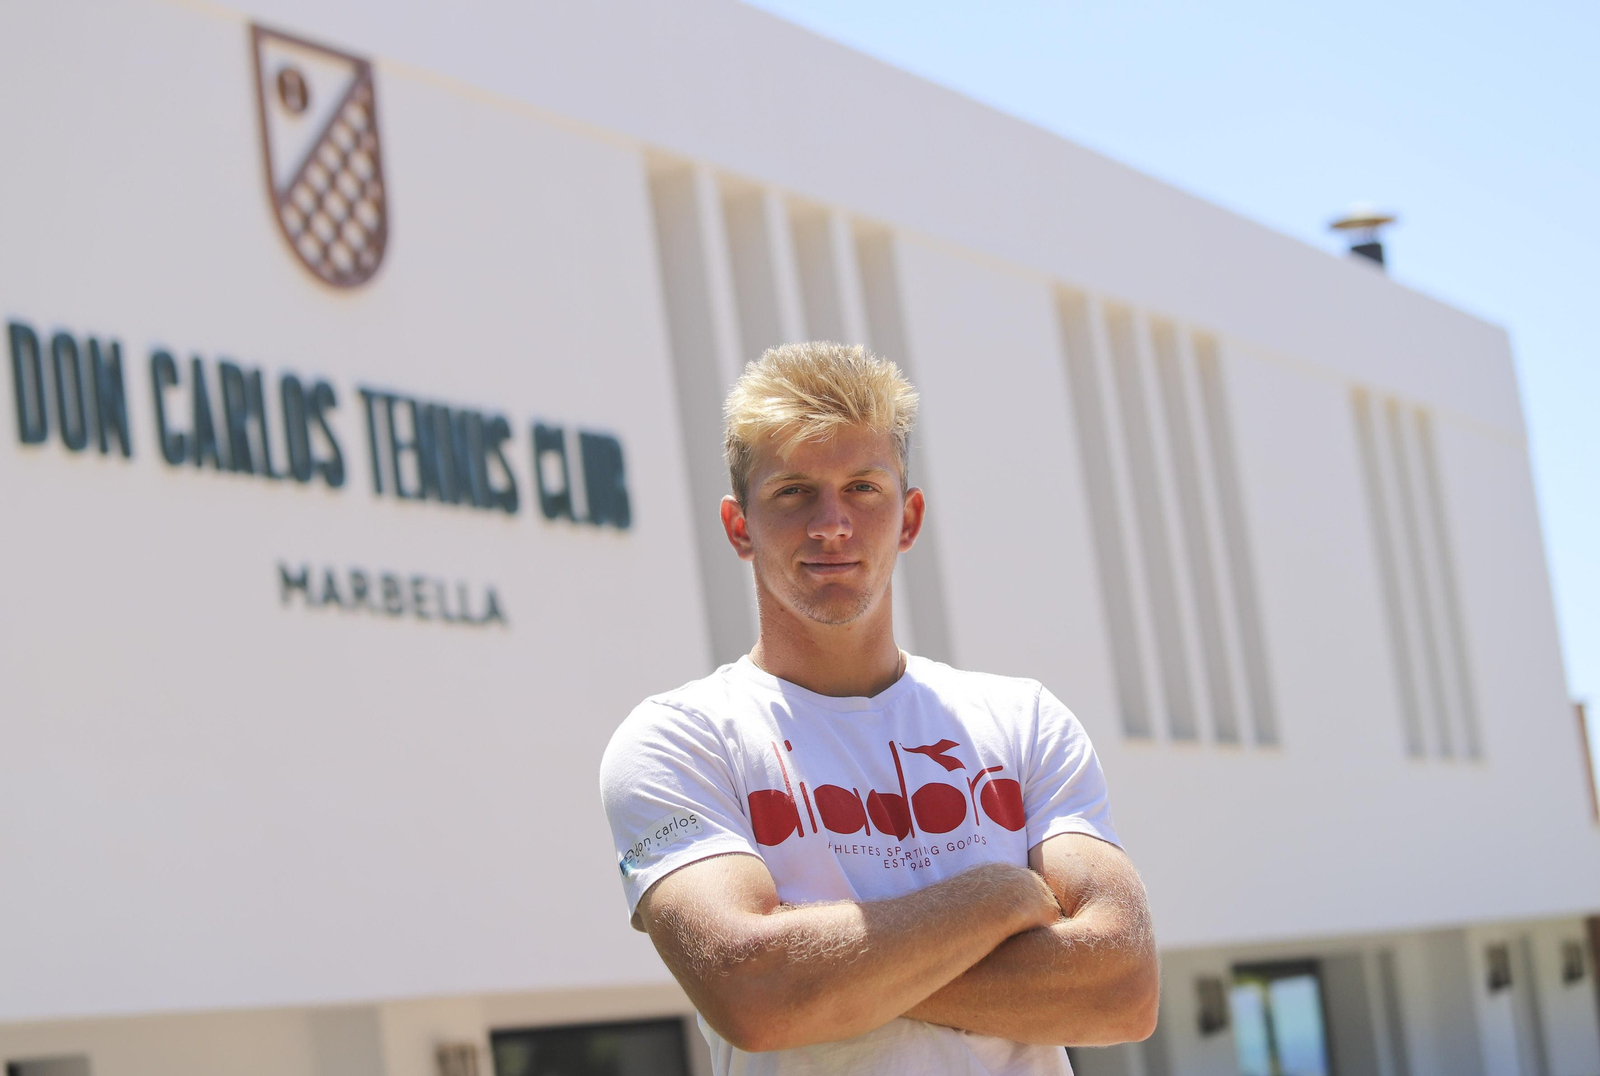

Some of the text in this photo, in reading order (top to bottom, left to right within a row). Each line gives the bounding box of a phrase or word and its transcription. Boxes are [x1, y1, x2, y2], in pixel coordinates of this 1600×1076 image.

[8, 320, 633, 529] DON CARLOS TENNIS CLUB
[278, 562, 508, 626] MARBELLA
[748, 739, 1026, 847] diadora
[634, 814, 697, 857] don carlos
[828, 833, 987, 861] HLETES SPRTING GOODS
[910, 857, 931, 871] 948
